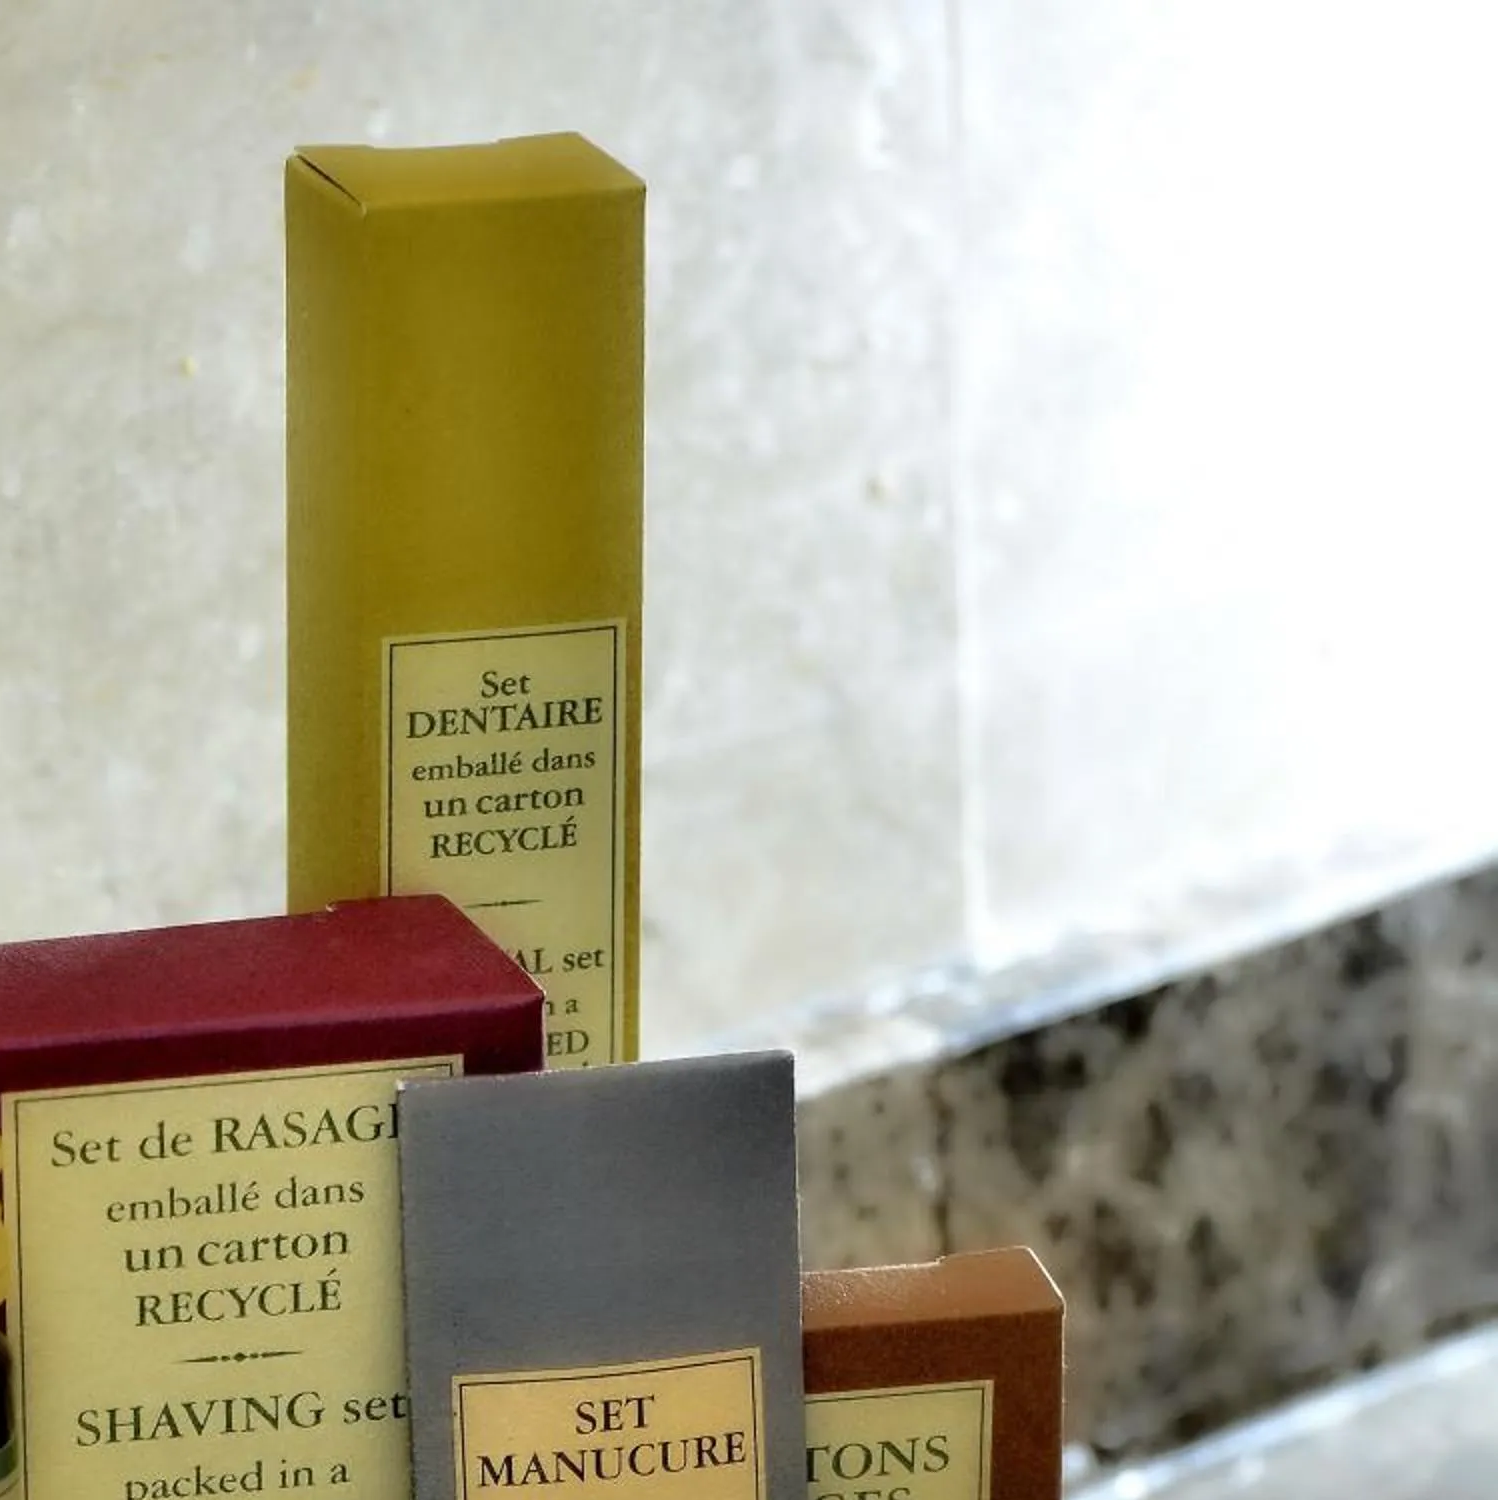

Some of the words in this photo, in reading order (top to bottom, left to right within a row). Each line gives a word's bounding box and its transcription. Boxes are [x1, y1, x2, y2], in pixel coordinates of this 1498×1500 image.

[481, 670, 531, 699] Set
[406, 697, 603, 739] DENTAIRE
[411, 751, 522, 782] emballé
[532, 748, 596, 773] dans
[424, 796, 467, 819] un
[475, 786, 584, 815] carton
[430, 816, 577, 859] RECYCLÉ
[562, 949, 604, 970] set
[50, 1130, 121, 1169] Set
[138, 1120, 194, 1160] de
[106, 1181, 259, 1224] emballé
[275, 1176, 365, 1210] dans
[123, 1242, 183, 1273] un
[197, 1229, 348, 1268] carton
[135, 1268, 342, 1327] RECYCLÉ
[76, 1391, 324, 1448] SHAVING
[343, 1392, 407, 1425] set
[575, 1395, 655, 1435] SET
[279, 1459, 314, 1490] in
[328, 1464, 349, 1485] a
[477, 1431, 746, 1488] MANUCURE
[806, 1435, 949, 1483] TONS
